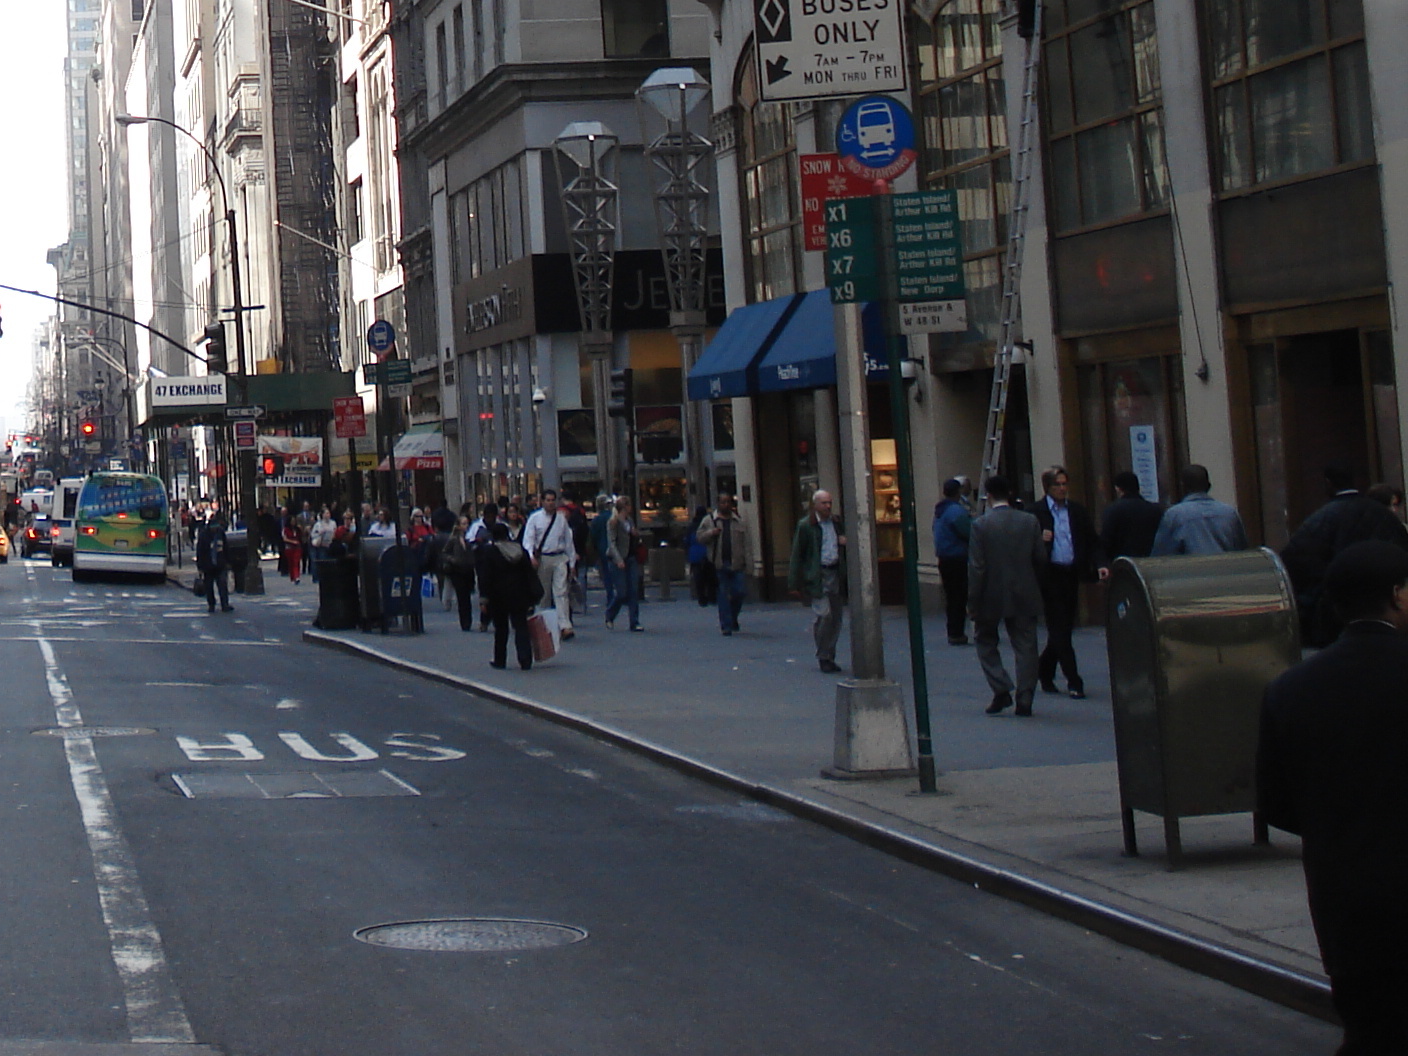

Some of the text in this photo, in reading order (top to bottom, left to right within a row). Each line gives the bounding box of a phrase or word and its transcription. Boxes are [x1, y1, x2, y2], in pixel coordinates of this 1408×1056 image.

[814, 19, 880, 45] ONLY
[814, 53, 839, 67] 7AM
[860, 50, 886, 64] 7PM
[804, 65, 898, 85] MON THRU FRI
[803, 159, 831, 176] SNOW
[863, 155, 910, 179] STANDING
[805, 199, 819, 212] NO
[894, 198, 920, 206] Staten
[895, 208, 920, 216] Arthur
[896, 224, 922, 233] Staten
[897, 234, 922, 242] Arthur
[898, 250, 925, 260] Staten
[900, 261, 925, 269] Arthur
[900, 277, 928, 285] Staten
[903, 305, 908, 314] 5
[912, 305, 943, 313] Avenue
[904, 317, 912, 326] W
[931, 316, 940, 325] St
[155, 383, 223, 397] 47 EXCHANGE
[417, 459, 441, 468] Pizza
[176, 731, 467, 762] BUS
